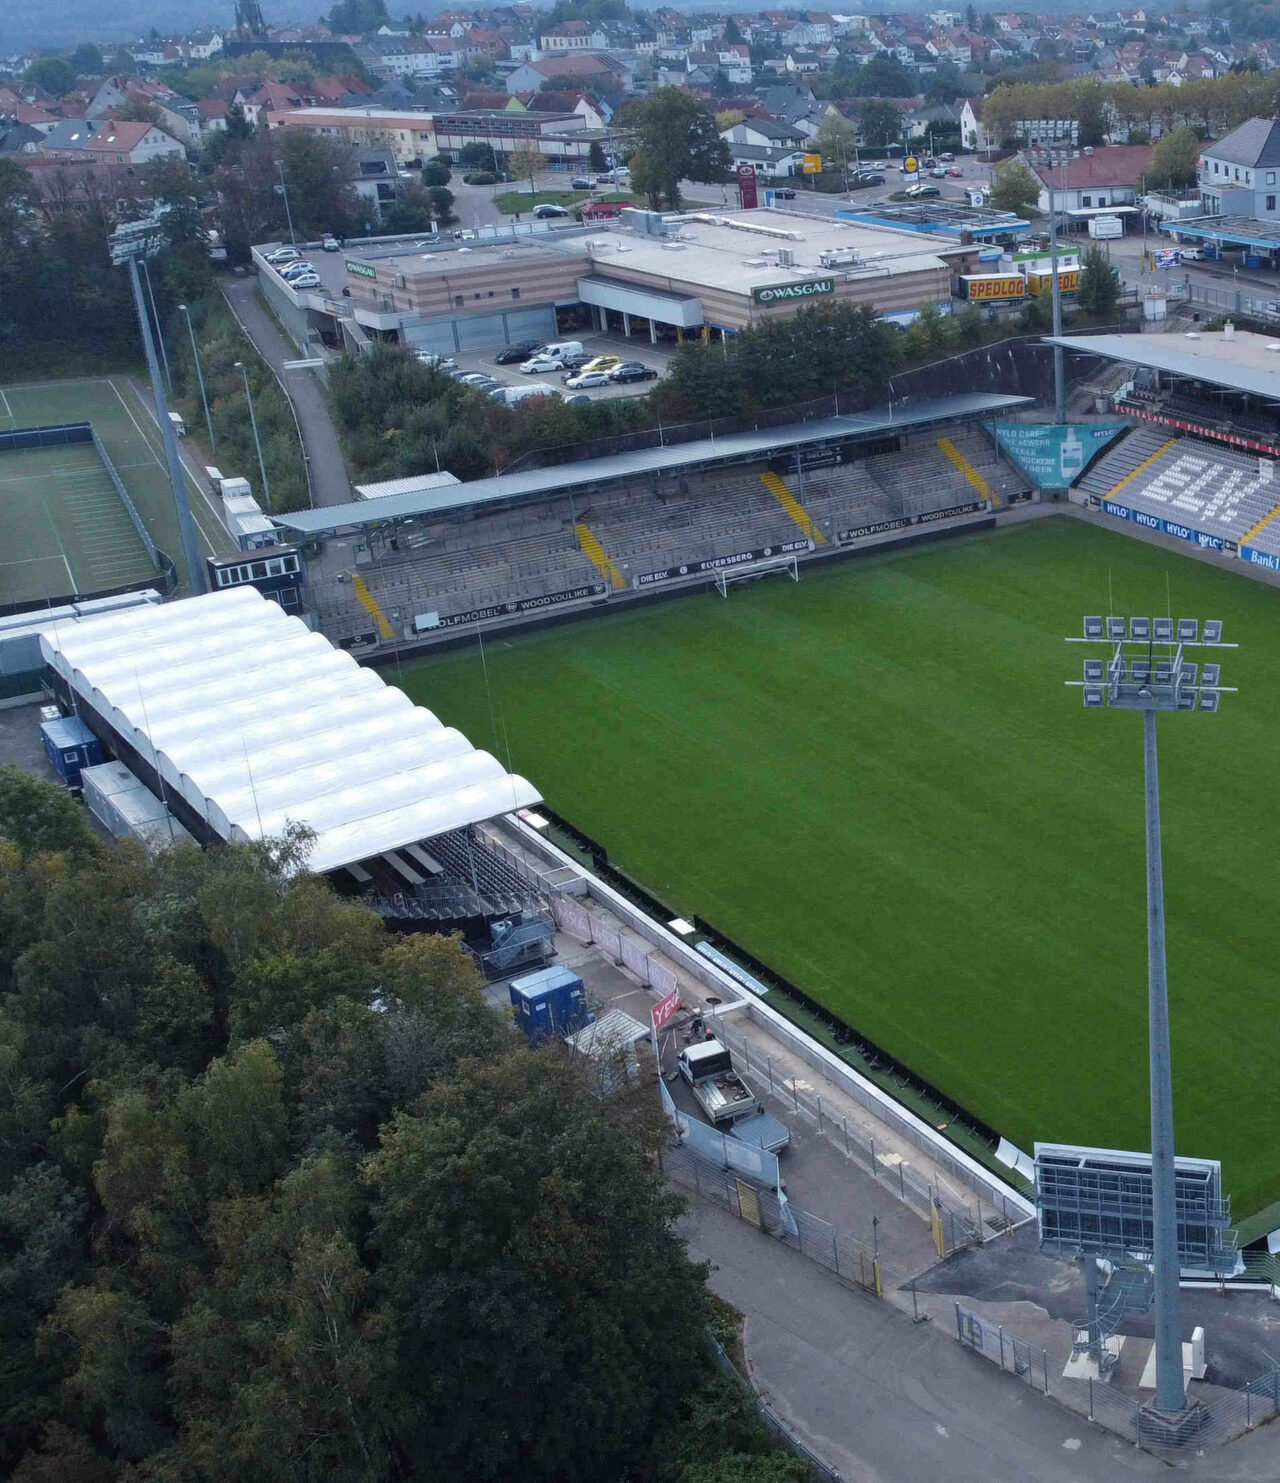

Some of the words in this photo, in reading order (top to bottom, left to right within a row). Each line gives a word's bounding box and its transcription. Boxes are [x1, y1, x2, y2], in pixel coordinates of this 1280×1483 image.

[773, 281, 831, 299] WASGAU
[969, 280, 1024, 298] SPEDLOG
[1115, 404, 1169, 425] FLYERALARM
[1187, 425, 1248, 447] FLYERALARM
[1106, 503, 1129, 518] HYLO
[1136, 512, 1159, 528] HYLO
[1166, 522, 1189, 538] HYLO
[701, 552, 753, 570] ELVERSBERG
[429, 607, 499, 630] OLFMÖBEL
